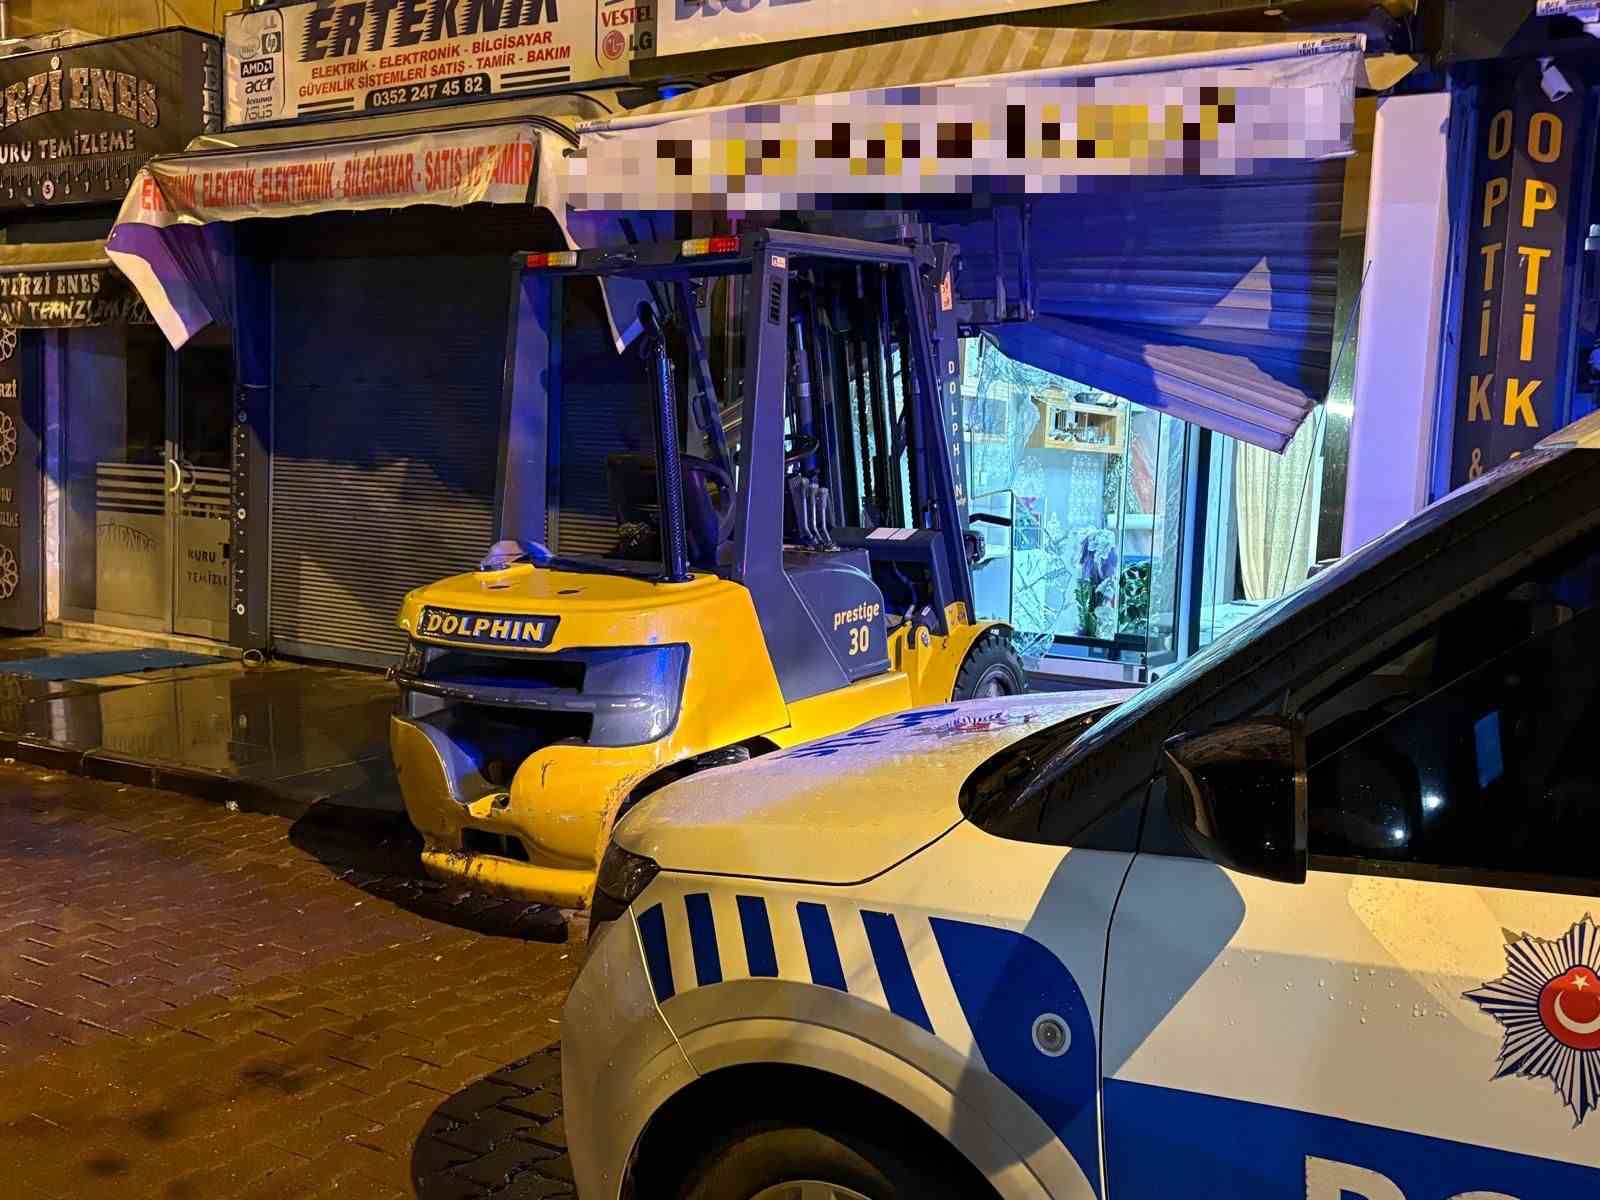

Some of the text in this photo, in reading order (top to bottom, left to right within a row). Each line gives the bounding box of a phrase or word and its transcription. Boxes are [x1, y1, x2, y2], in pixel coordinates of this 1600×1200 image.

[601, 5, 653, 27] VESTEL
[311, 59, 368, 80] ELEKTRİK
[379, 43, 460, 69] ELEKTRONİK
[472, 31, 552, 55] BİLGİSAYAR
[628, 31, 653, 51] LG
[245, 77, 275, 94] acer
[298, 77, 355, 98] GÜVENLİK
[358, 68, 427, 89] SİSTEMLERİ
[476, 51, 516, 70] TAMİR
[526, 45, 571, 64] BAKIM
[69, 67, 159, 129] ENES
[371, 76, 483, 107] 0352 247 45 82
[38, 129, 135, 159] TEMİZLEME
[203, 160, 256, 208] ELEKTRİK
[262, 152, 336, 203] ELEKTRONİK
[343, 150, 416, 199] BİLGİSAYAR
[424, 148, 462, 198] SATIŞ
[1466, 109, 1513, 423] OPTİK
[1503, 111, 1563, 428] OPTİK
[56, 273, 100, 295] ENES
[948, 360, 963, 498] DOLPHIN
[427, 613, 545, 642] DOLPHIN
[834, 601, 880, 631] prestige
[848, 625, 870, 656] 30
